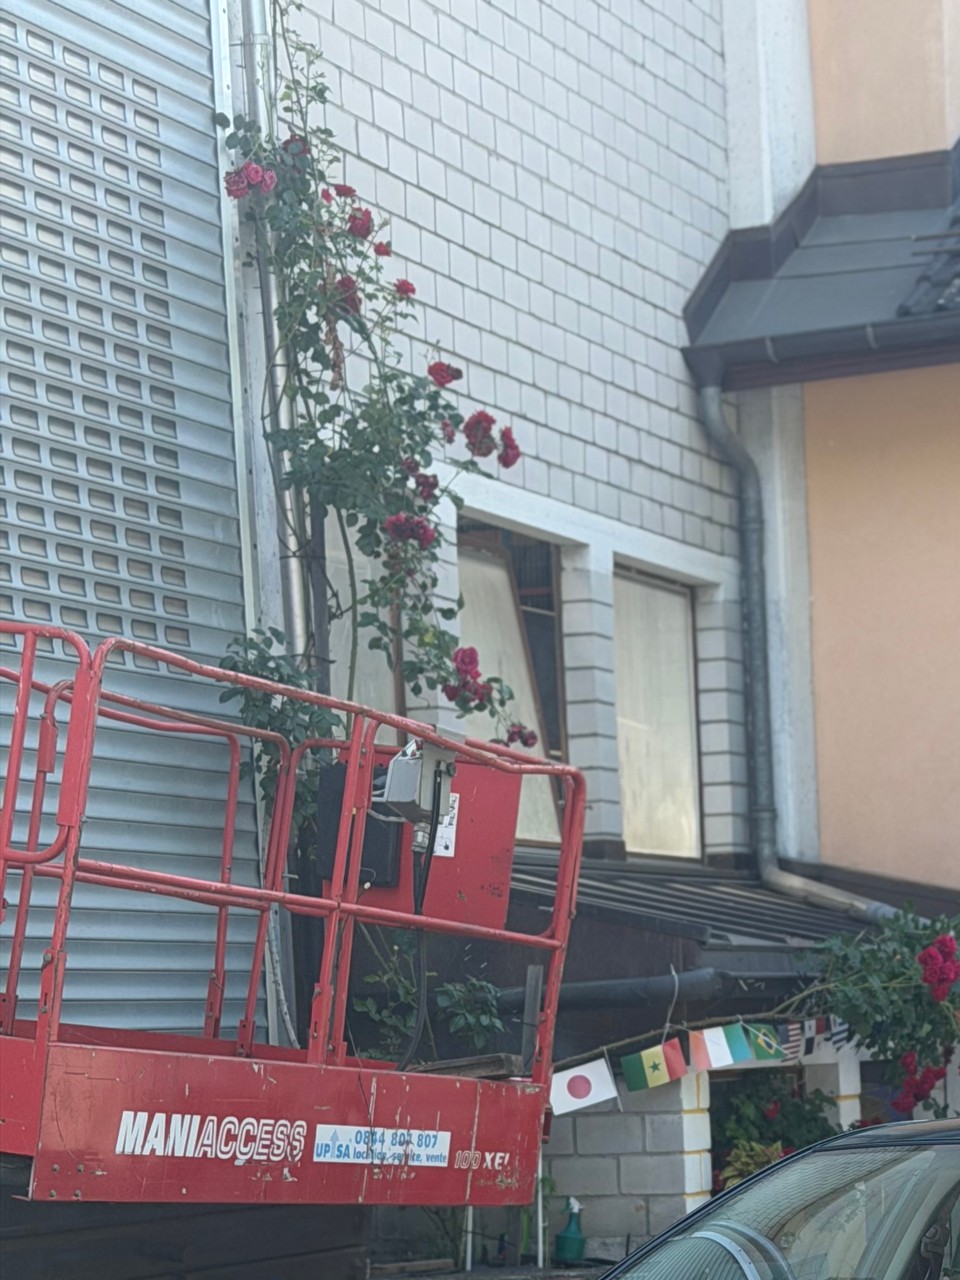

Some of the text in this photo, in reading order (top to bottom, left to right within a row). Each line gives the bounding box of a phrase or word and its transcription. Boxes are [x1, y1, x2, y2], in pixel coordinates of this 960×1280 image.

[417, 1134, 438, 1149] 807
[315, 1142, 351, 1159] UP SA
[425, 1152, 447, 1164] vente
